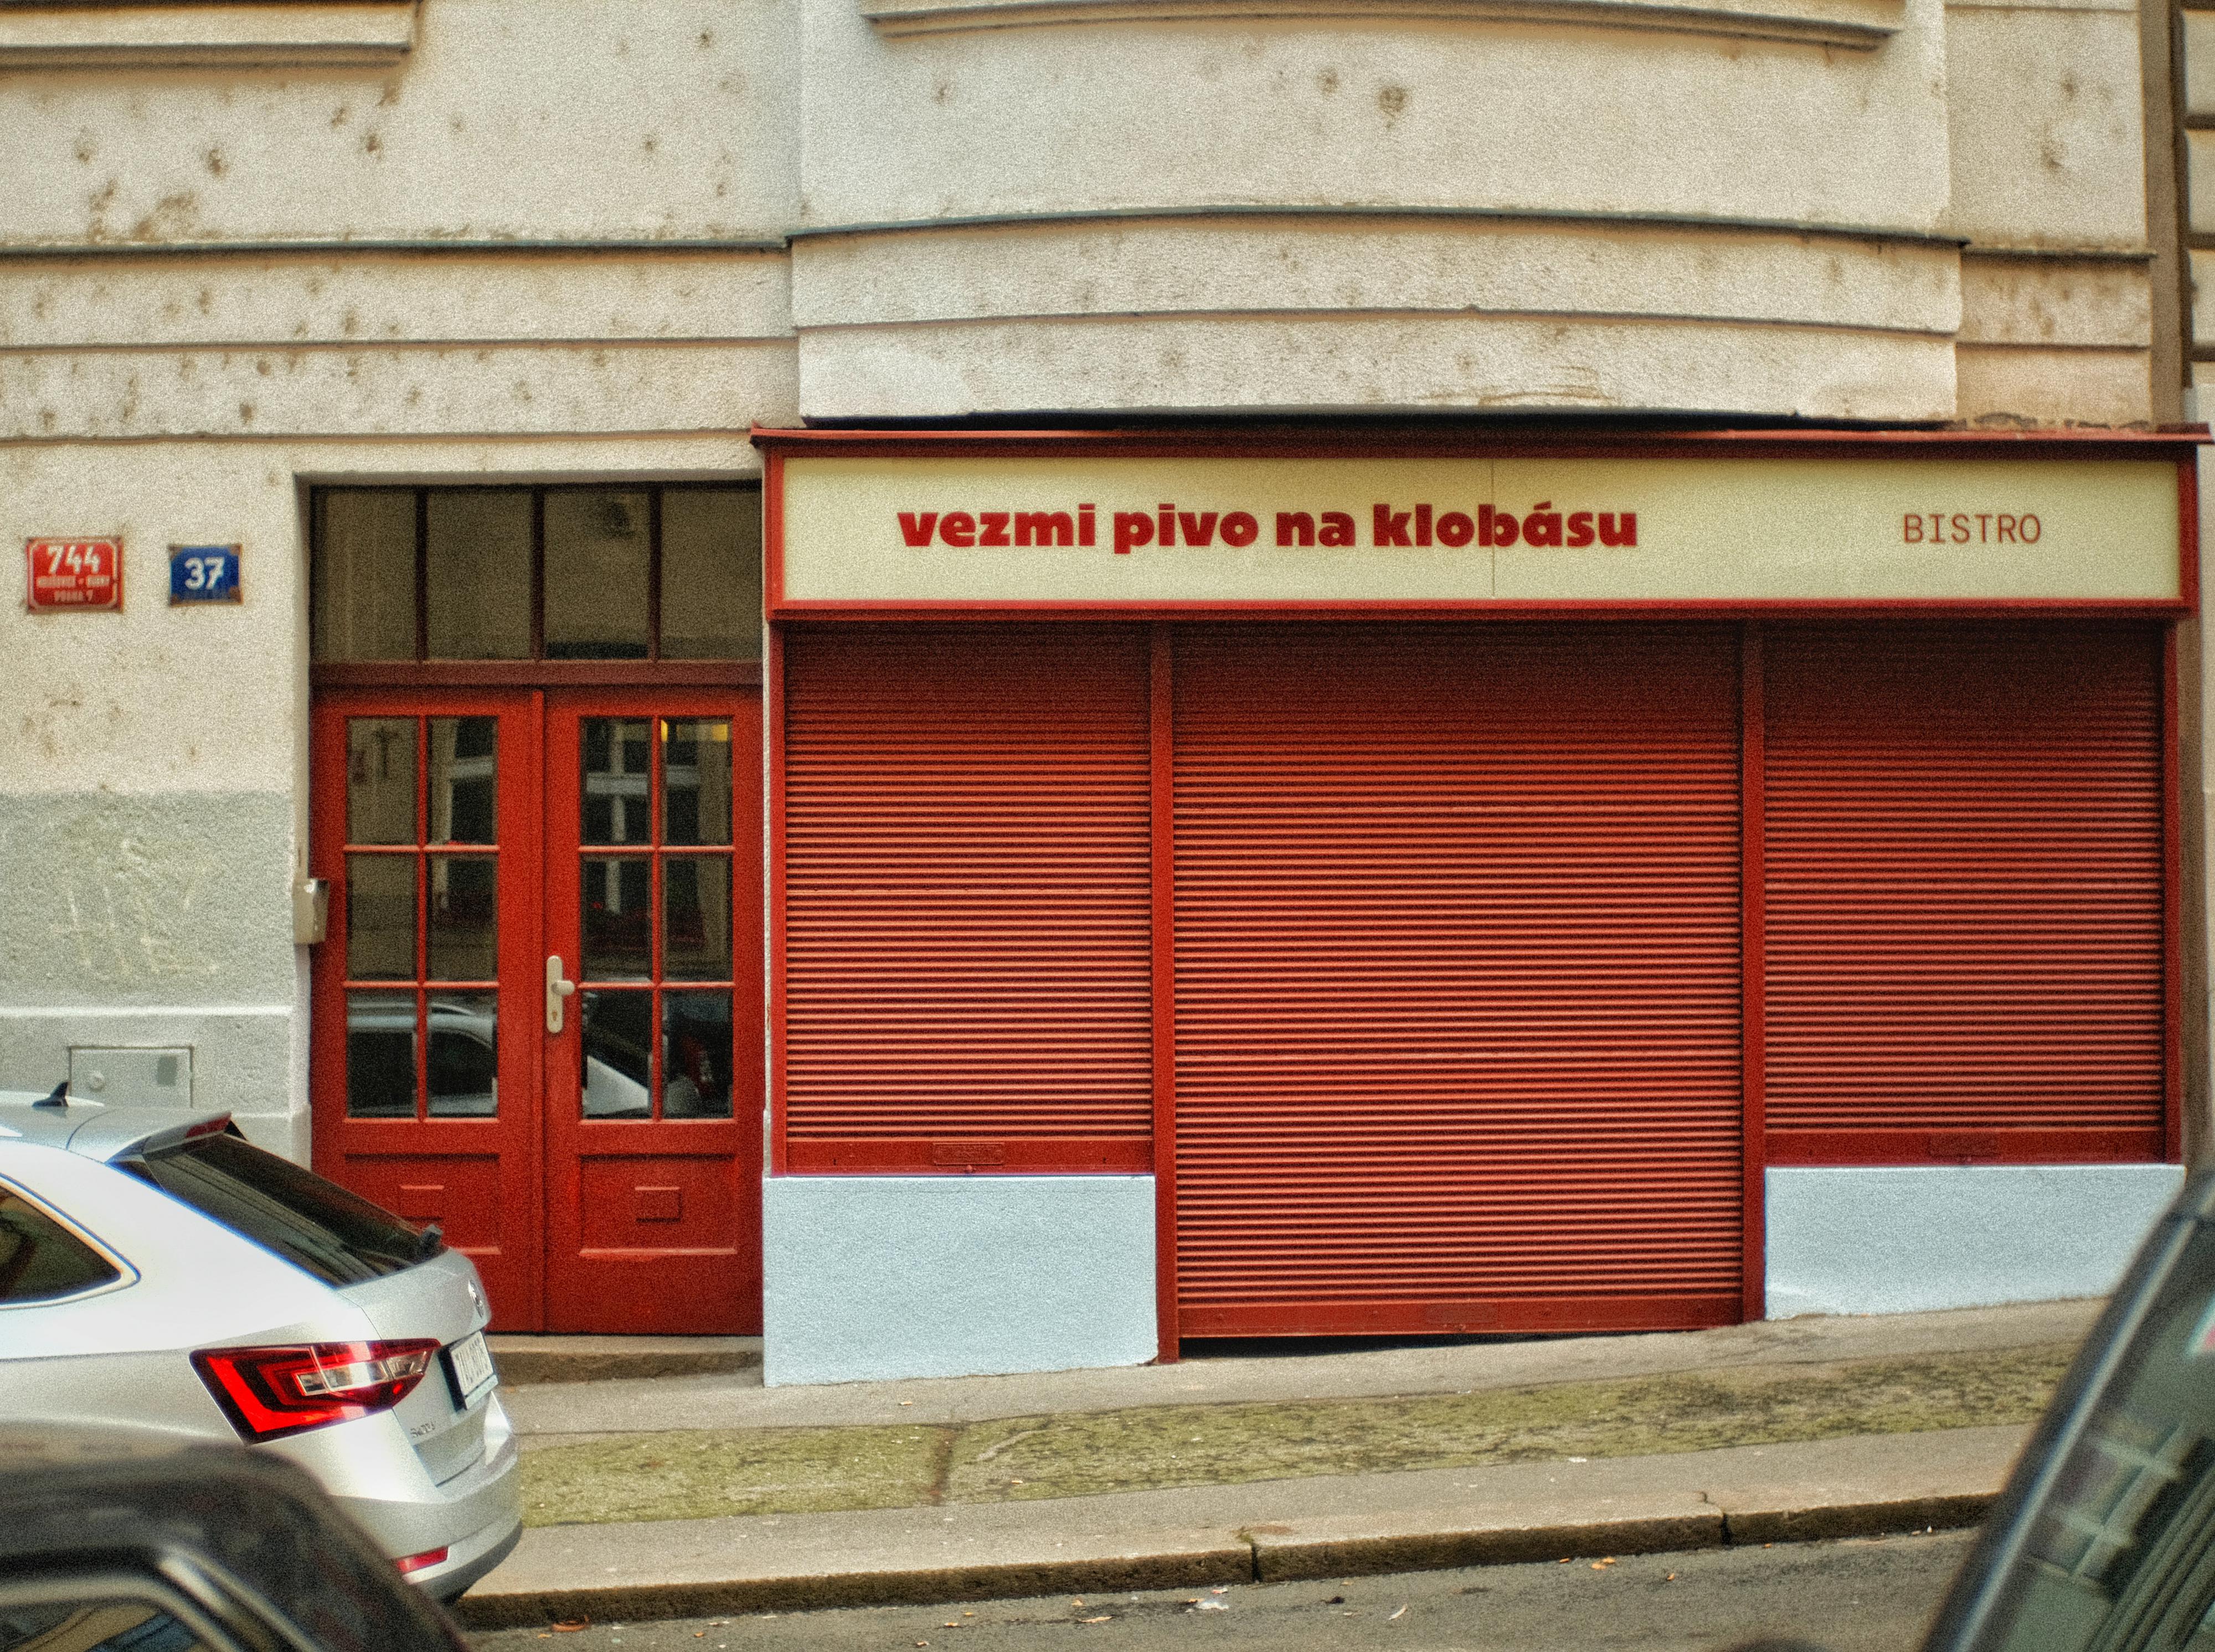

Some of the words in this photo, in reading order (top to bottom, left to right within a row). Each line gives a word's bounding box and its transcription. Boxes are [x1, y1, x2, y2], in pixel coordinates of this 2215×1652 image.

[897, 503, 1096, 548] vezmi
[1113, 503, 1259, 555] pivo
[1275, 512, 1356, 548] na
[1373, 502, 1637, 548] klobásu
[1903, 514, 2041, 543] BISTRO
[48, 545, 100, 574] 744
[184, 556, 225, 590] 37
